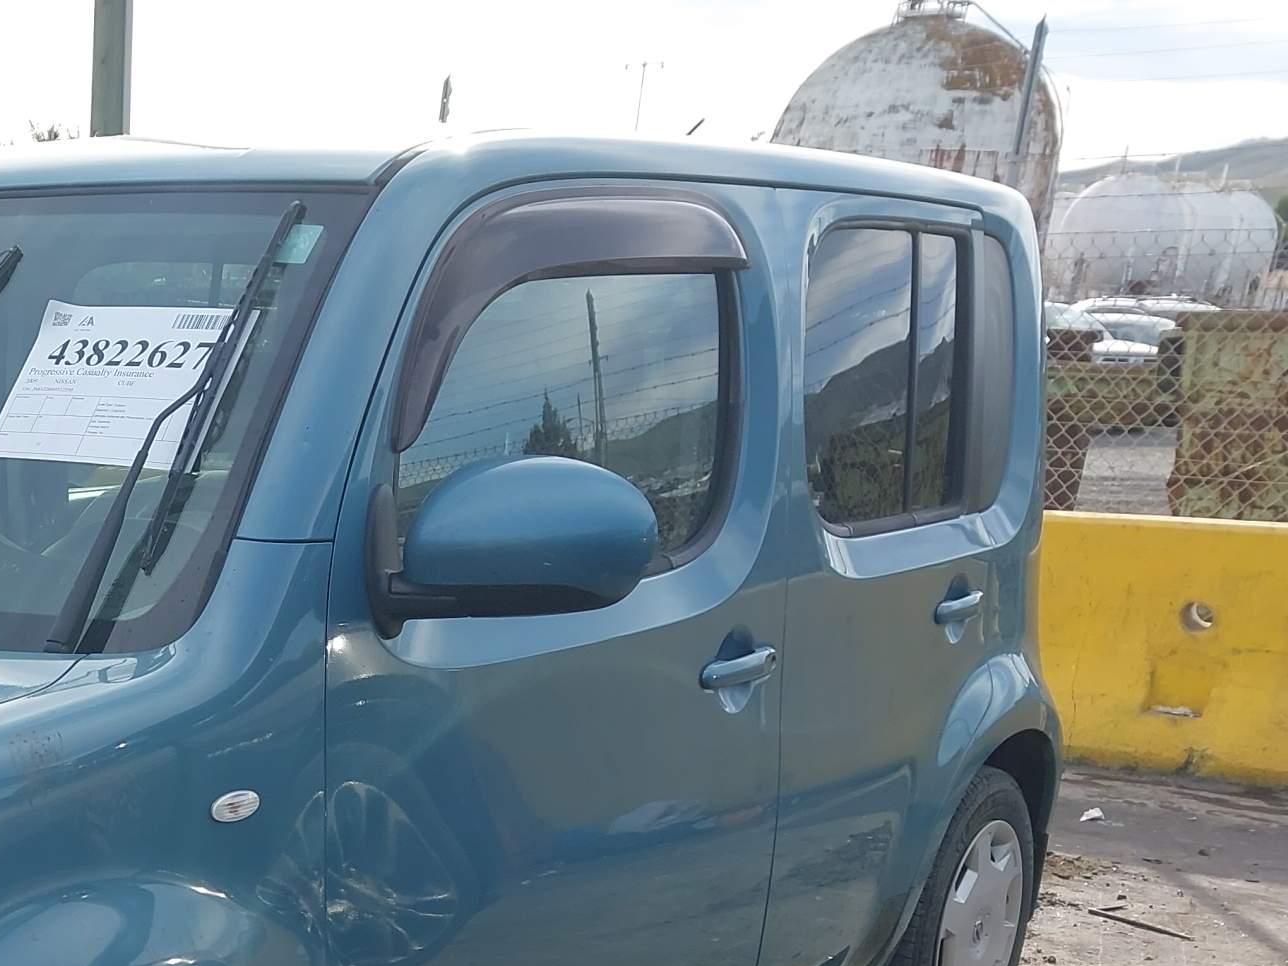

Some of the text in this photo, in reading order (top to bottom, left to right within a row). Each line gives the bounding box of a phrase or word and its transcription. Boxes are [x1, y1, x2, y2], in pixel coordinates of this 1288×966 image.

[48, 338, 215, 370] 43822627
[28, 367, 154, 379] Progressive Casualty Insurance
